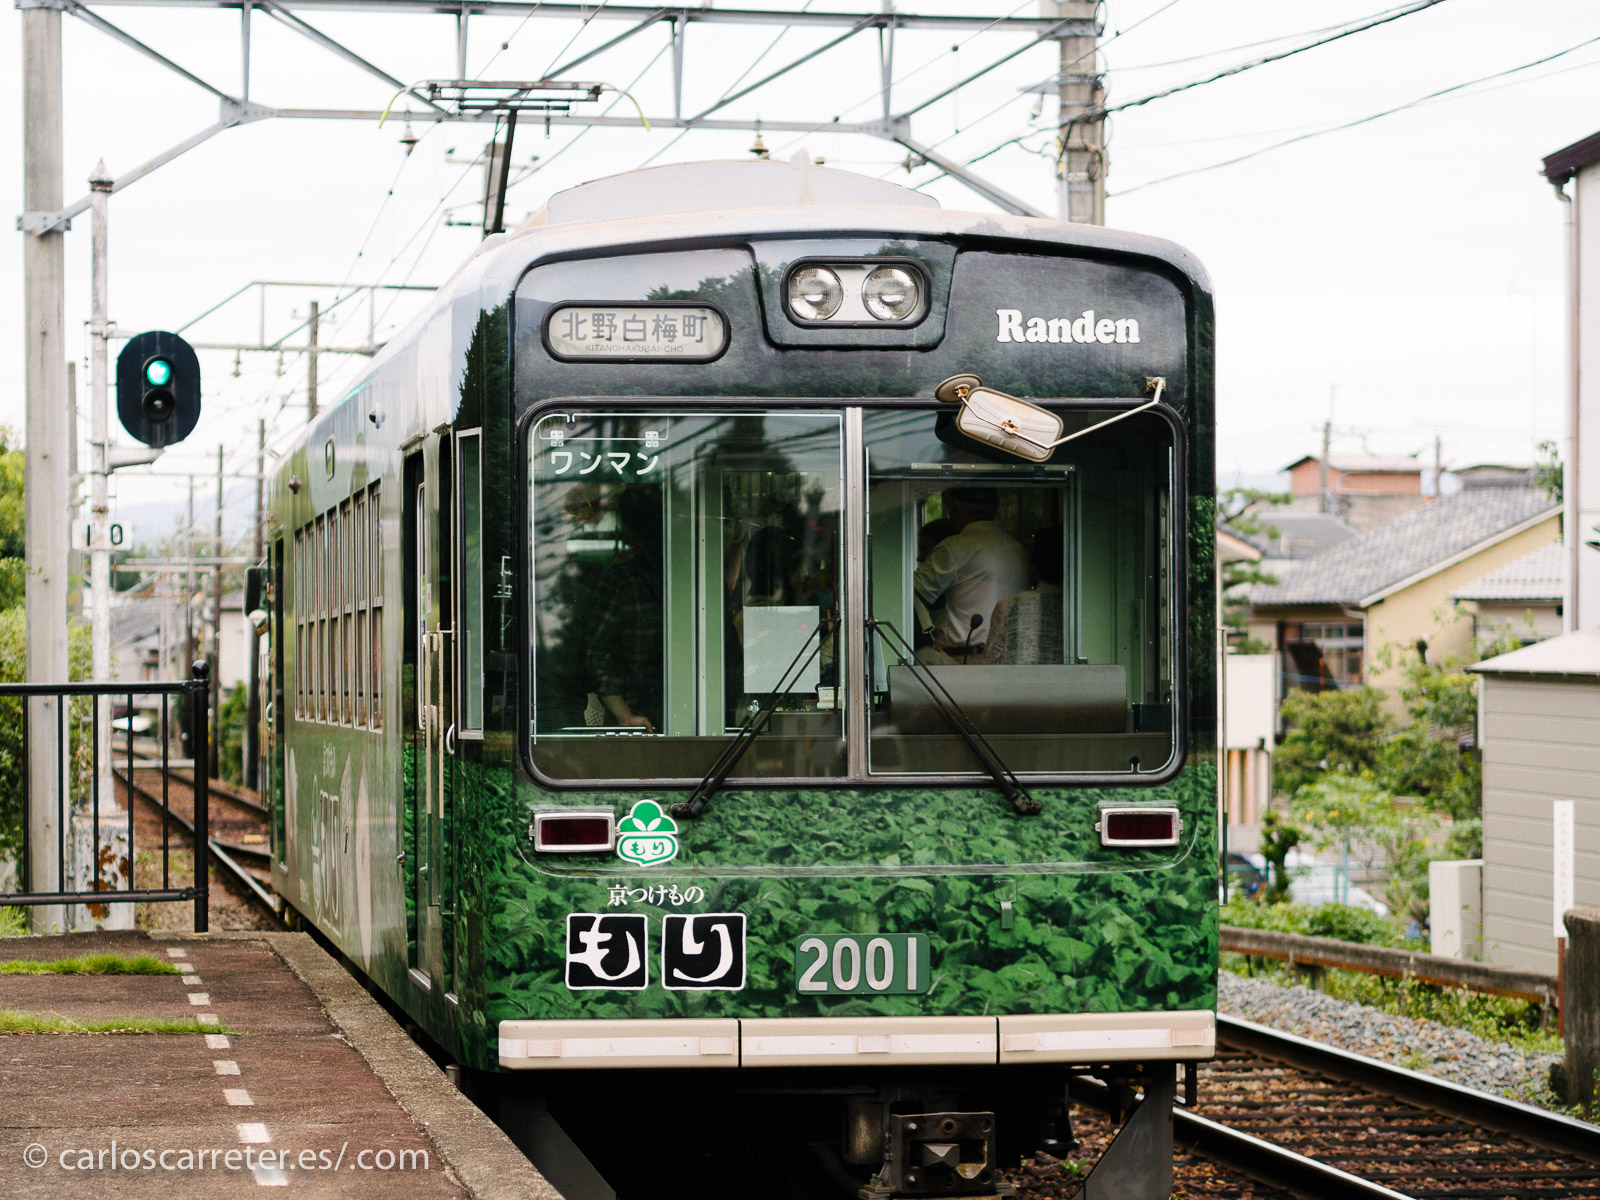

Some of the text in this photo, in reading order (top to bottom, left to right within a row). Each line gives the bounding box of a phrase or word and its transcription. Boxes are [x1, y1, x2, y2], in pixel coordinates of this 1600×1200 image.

[562, 312, 707, 343] 北野白梅町
[996, 309, 1140, 343] Randen
[586, 344, 684, 353] KITANOHAKUBAI-CHO
[551, 451, 658, 475] ワンマン
[630, 841, 665, 856] もり
[607, 884, 705, 906] 京つけもの
[566, 914, 744, 989] もり
[798, 937, 918, 991] 2001
